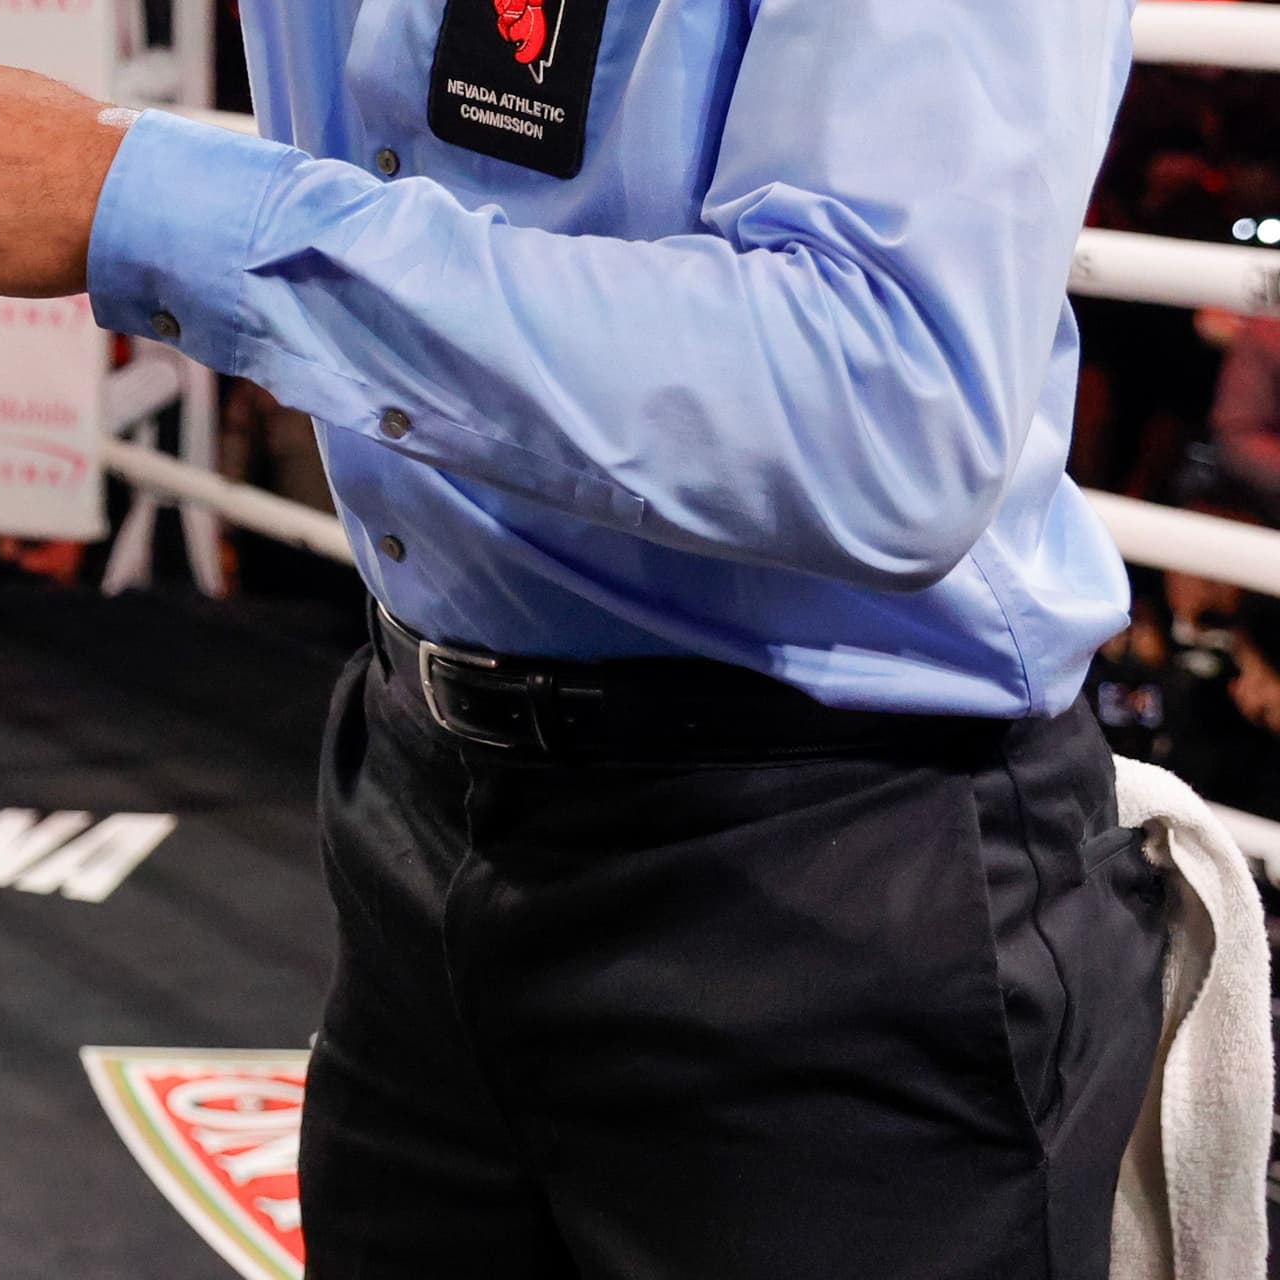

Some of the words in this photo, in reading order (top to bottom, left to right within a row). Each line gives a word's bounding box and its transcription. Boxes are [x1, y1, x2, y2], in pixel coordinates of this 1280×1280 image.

[447, 78, 497, 106] NEVADA
[499, 92, 565, 123] ATHLETIC
[460, 104, 543, 140] COMMISSION
